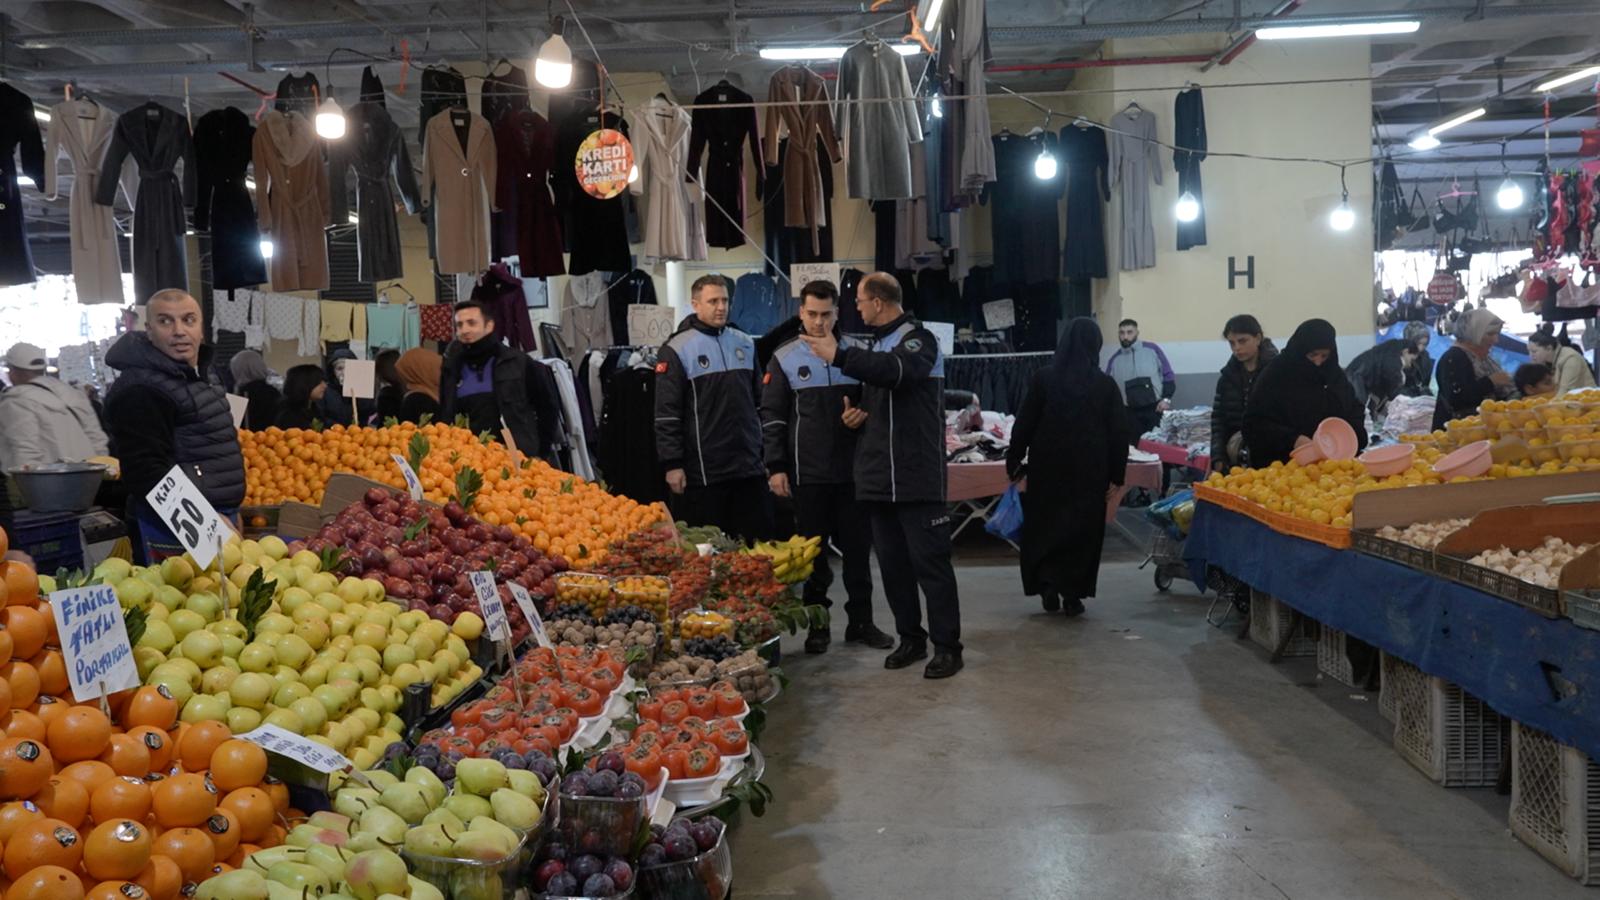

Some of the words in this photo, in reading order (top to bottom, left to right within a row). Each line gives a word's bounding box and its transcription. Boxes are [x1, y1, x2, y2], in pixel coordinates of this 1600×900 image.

[583, 142, 626, 161] KREDİ
[583, 158, 627, 175] KARTI
[1228, 255, 1255, 289] H
[170, 498, 204, 549] 50
[69, 611, 117, 657] TATLI
